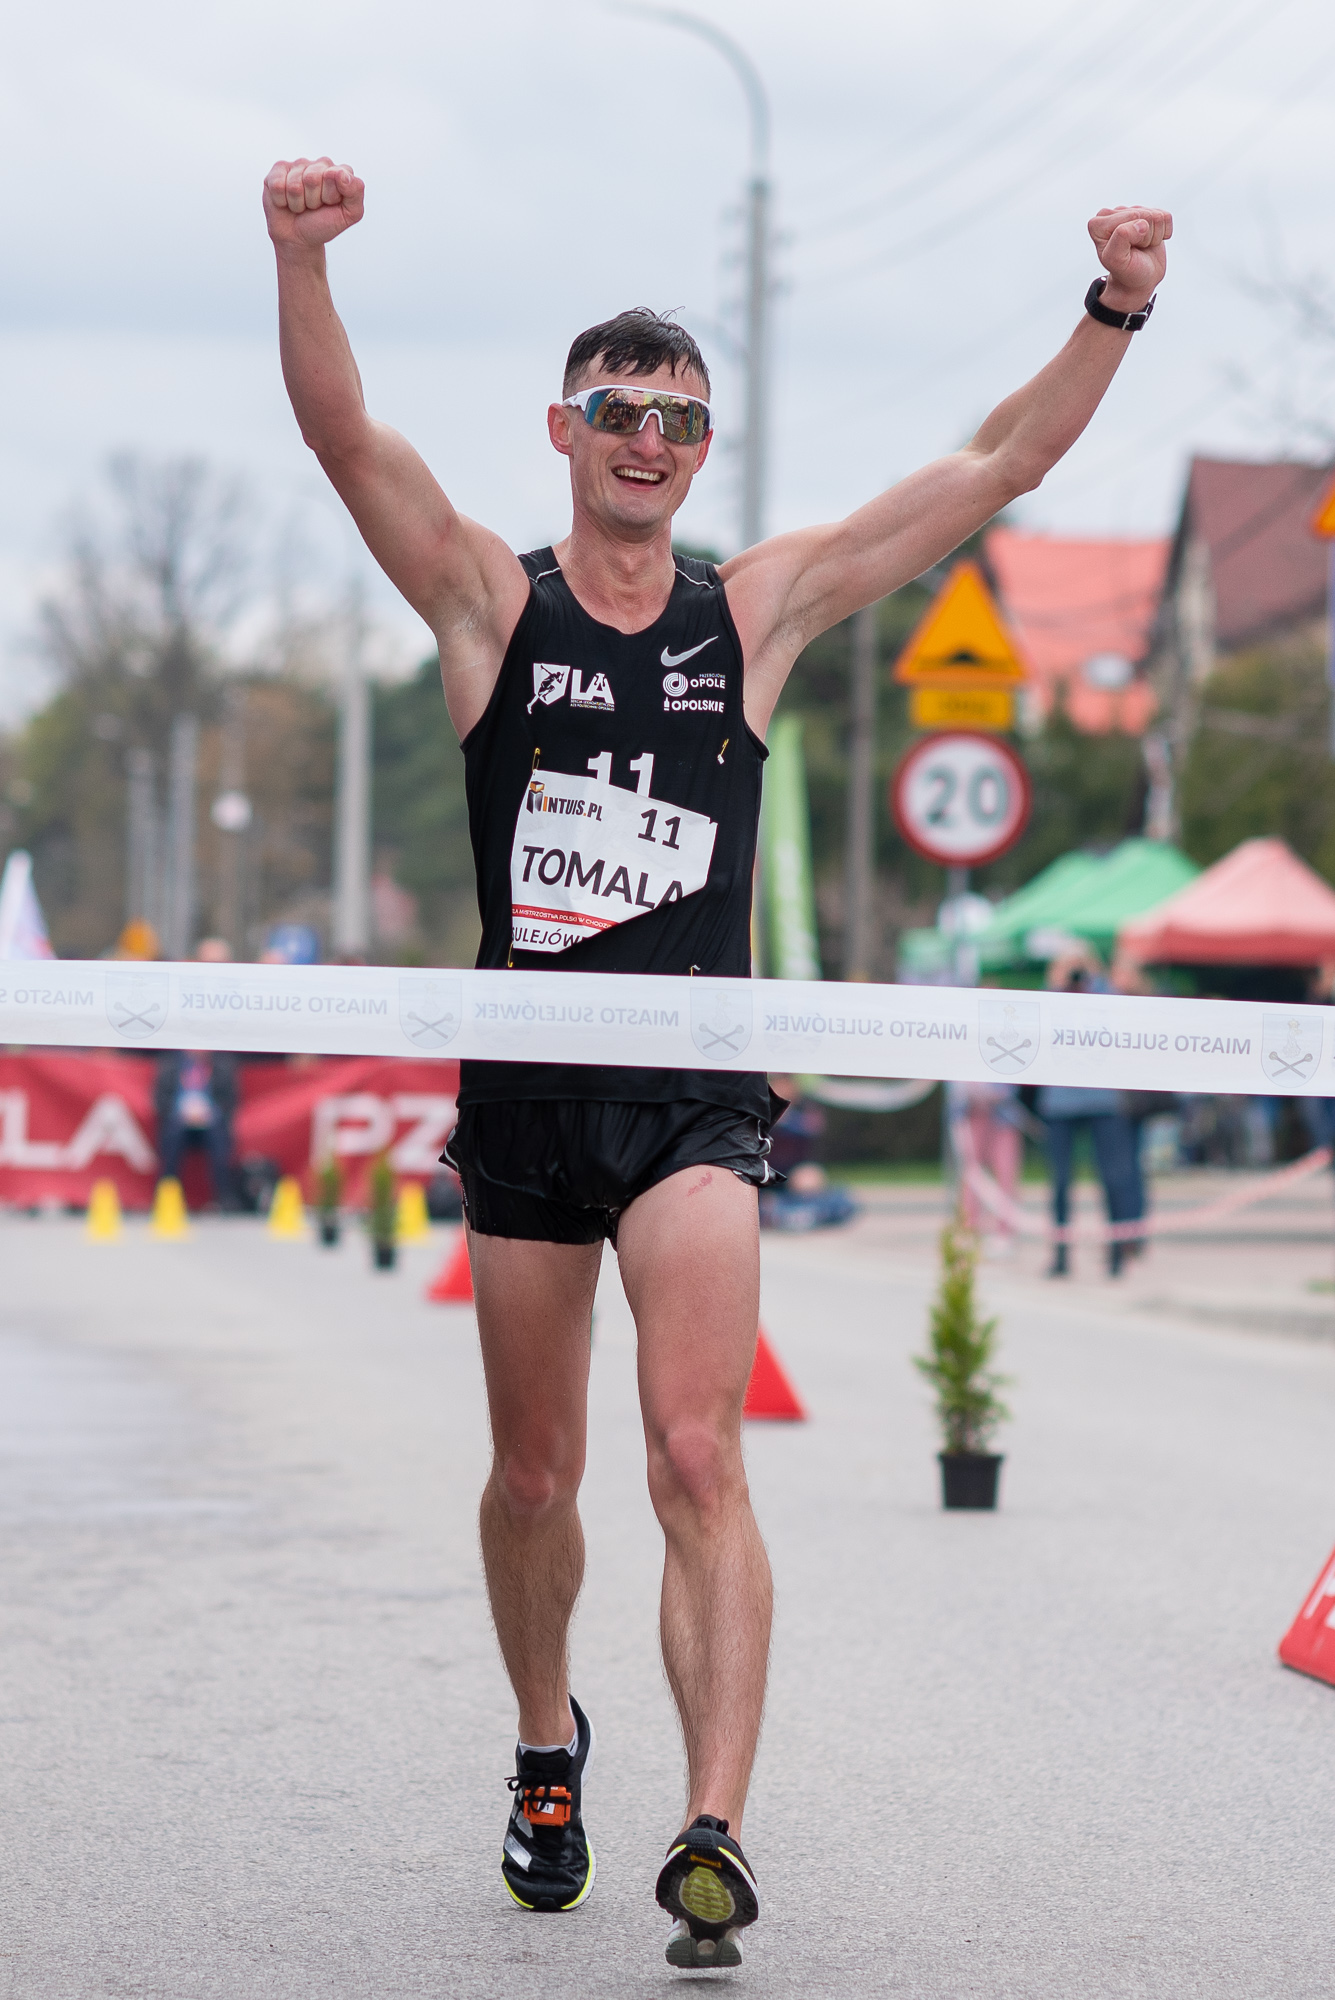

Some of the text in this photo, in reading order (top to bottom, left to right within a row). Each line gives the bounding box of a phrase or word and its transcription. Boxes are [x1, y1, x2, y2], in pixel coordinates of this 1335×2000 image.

[671, 700, 725, 713] OPOLSKIE
[690, 678, 725, 689] OPOLE
[587, 751, 654, 798] 11
[924, 765, 1008, 828] 20
[638, 808, 681, 850] 11
[522, 845, 683, 909] TOMALA
[0, 1088, 158, 1172] LA
